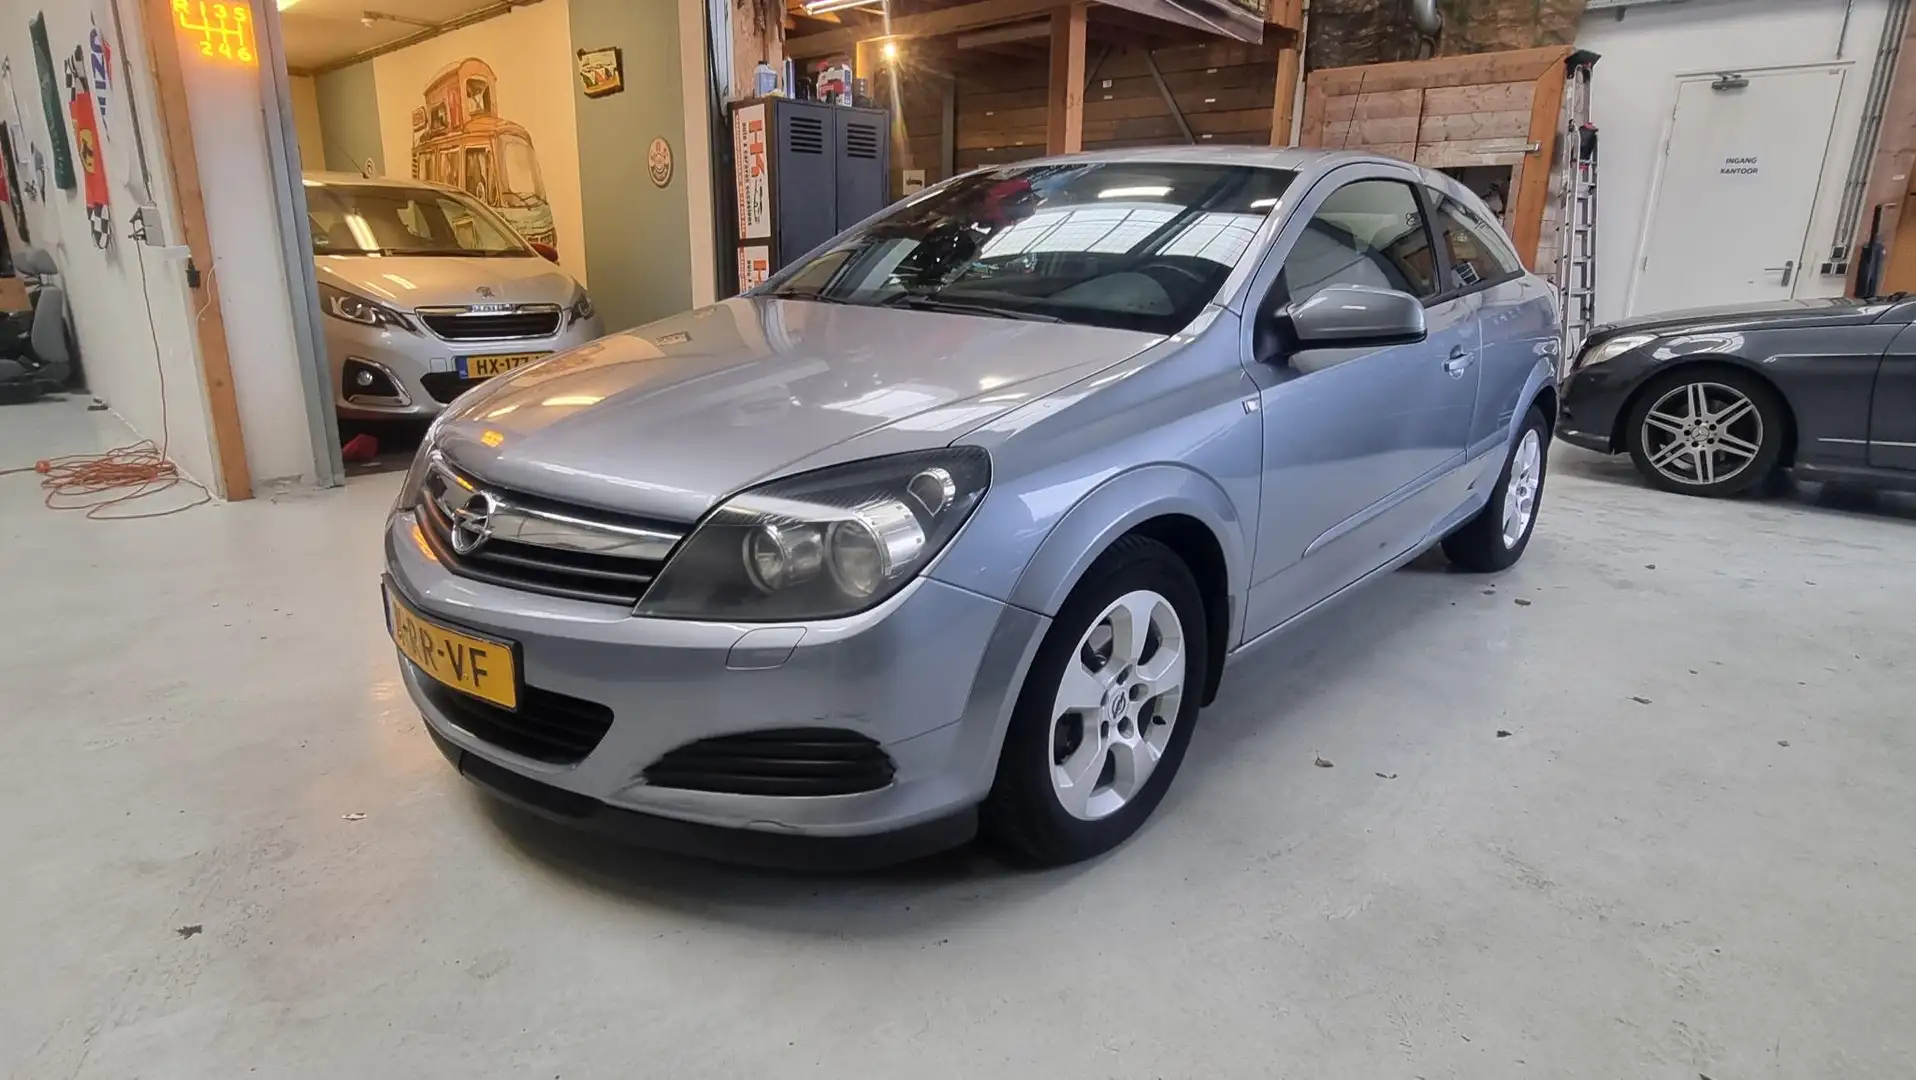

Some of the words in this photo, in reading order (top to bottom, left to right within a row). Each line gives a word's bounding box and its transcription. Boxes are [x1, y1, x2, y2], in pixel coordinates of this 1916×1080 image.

[212, 3, 228, 19] 3
[233, 7, 247, 22] 5
[199, 41, 214, 56] 2
[218, 42, 232, 60] 4
[237, 46, 253, 62] 6
[749, 120, 765, 178] HK
[1720, 167, 1759, 175] KANTOOR
[476, 356, 540, 375] HX-177
